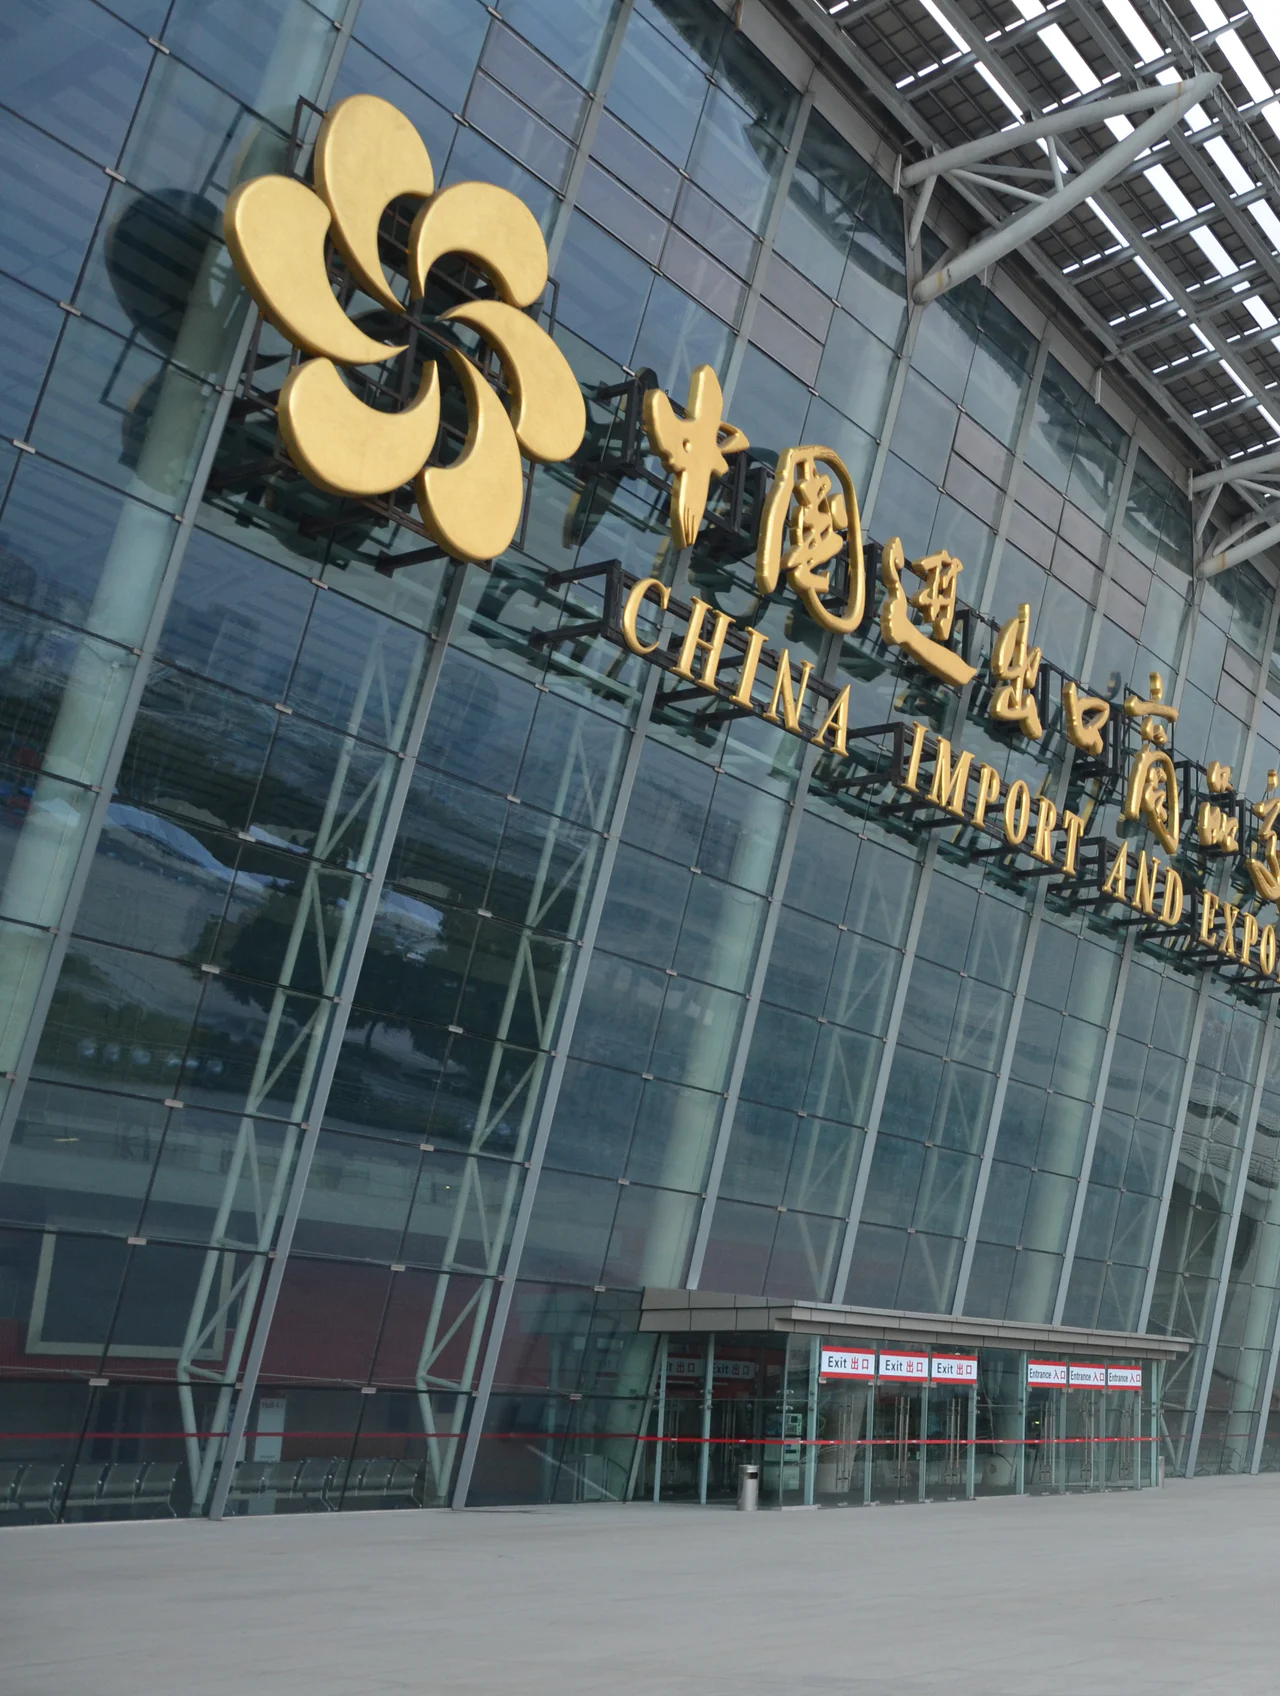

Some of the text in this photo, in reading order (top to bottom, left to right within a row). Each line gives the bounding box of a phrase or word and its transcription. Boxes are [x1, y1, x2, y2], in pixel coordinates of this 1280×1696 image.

[621, 577, 851, 757] CHINA
[901, 720, 1085, 877] IMPORT
[1102, 841, 1184, 926] AND
[676, 1362, 695, 1374] 出口
[827, 1356, 869, 1370] Exit 出口
[885, 1359, 923, 1373] Exit 出口
[936, 1362, 973, 1375] Exit 出口
[732, 1364, 749, 1376] 出口
[1029, 1368, 1066, 1380] Entrance 入口
[1070, 1370, 1105, 1382] Entrance 入口
[1108, 1372, 1141, 1383] Entrance 入口
